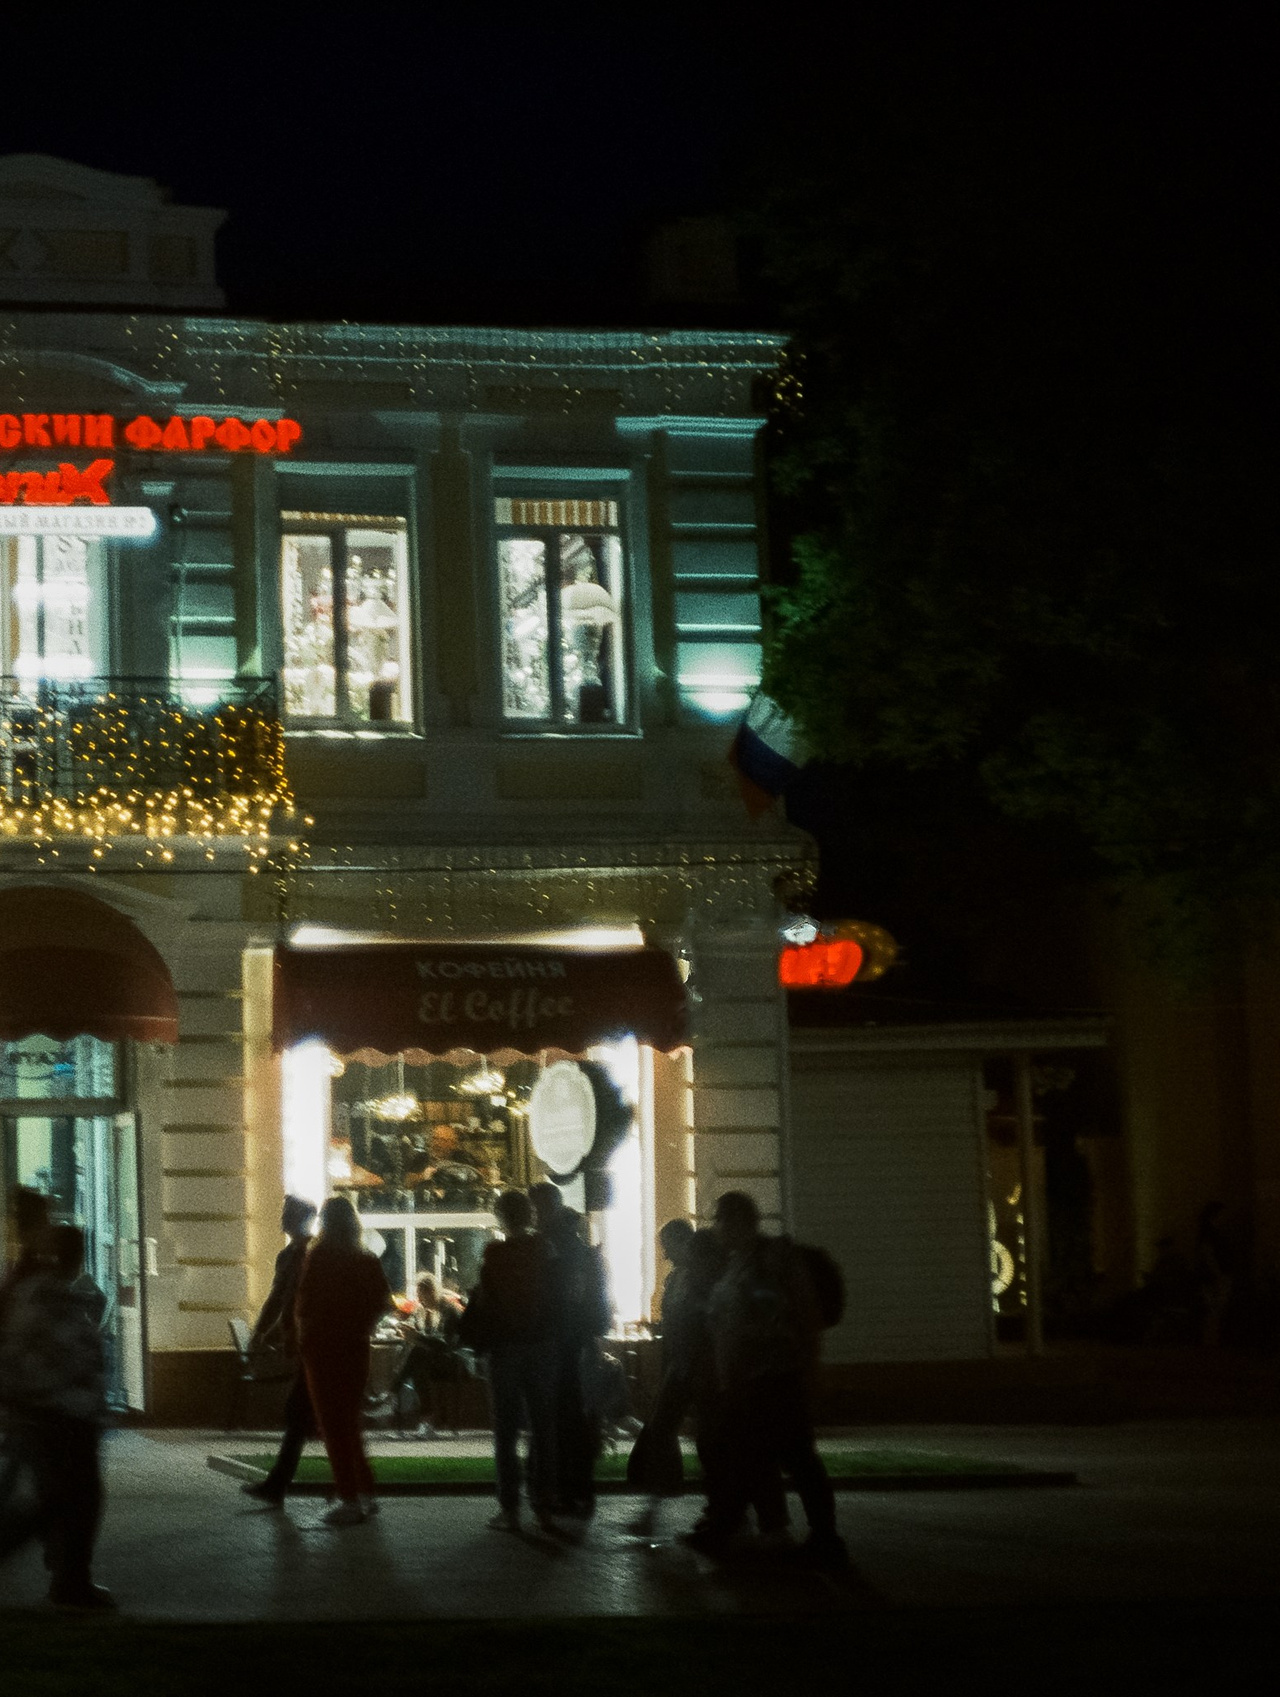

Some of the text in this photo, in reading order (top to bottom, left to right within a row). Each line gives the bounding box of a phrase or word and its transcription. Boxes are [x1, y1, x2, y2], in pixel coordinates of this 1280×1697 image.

[124, 415, 302, 453] ФАРФОР
[415, 956, 567, 979] КОФЕЙНЯ
[464, 987, 576, 1029] Coffee
